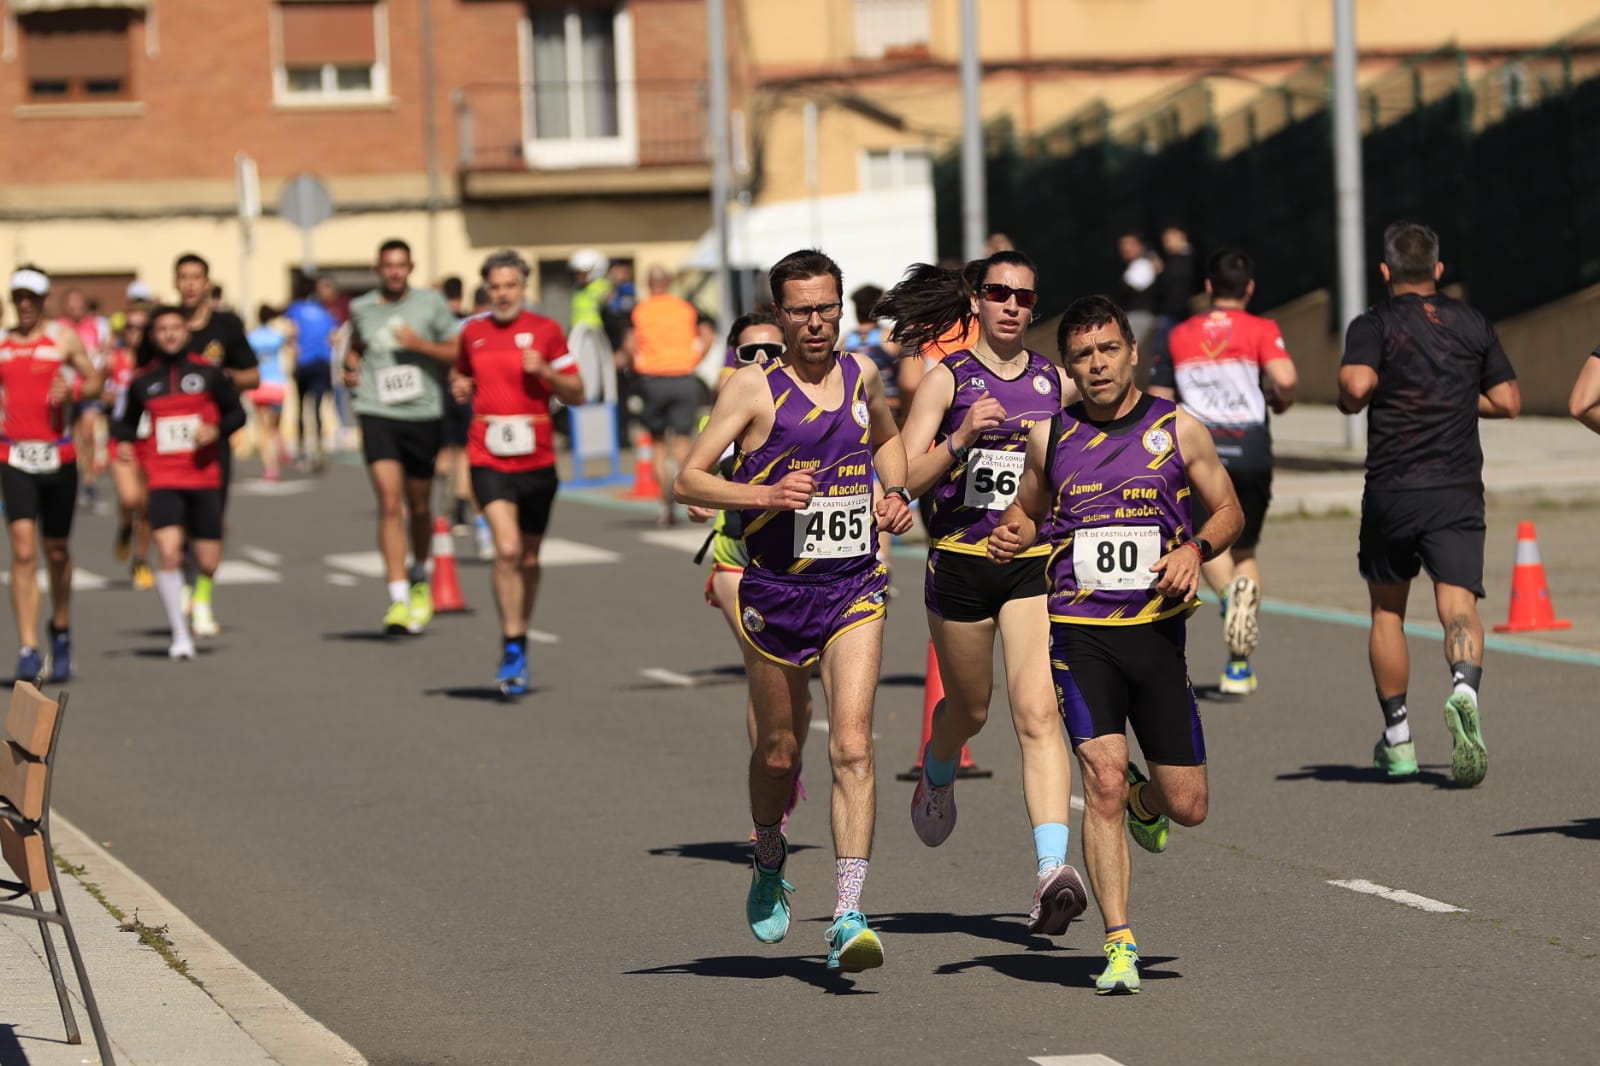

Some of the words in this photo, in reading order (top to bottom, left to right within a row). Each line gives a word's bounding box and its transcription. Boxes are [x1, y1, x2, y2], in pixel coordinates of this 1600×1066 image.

[1021, 419, 1038, 428] PR
[1011, 432, 1029, 441] Mac
[788, 458, 821, 470] Jamón
[838, 464, 866, 477] PRIM
[974, 468, 1021, 495] 56
[1070, 482, 1103, 496] Jamón
[1123, 488, 1158, 500] PRIM
[806, 508, 863, 541] 465
[1097, 541, 1138, 573] 80
